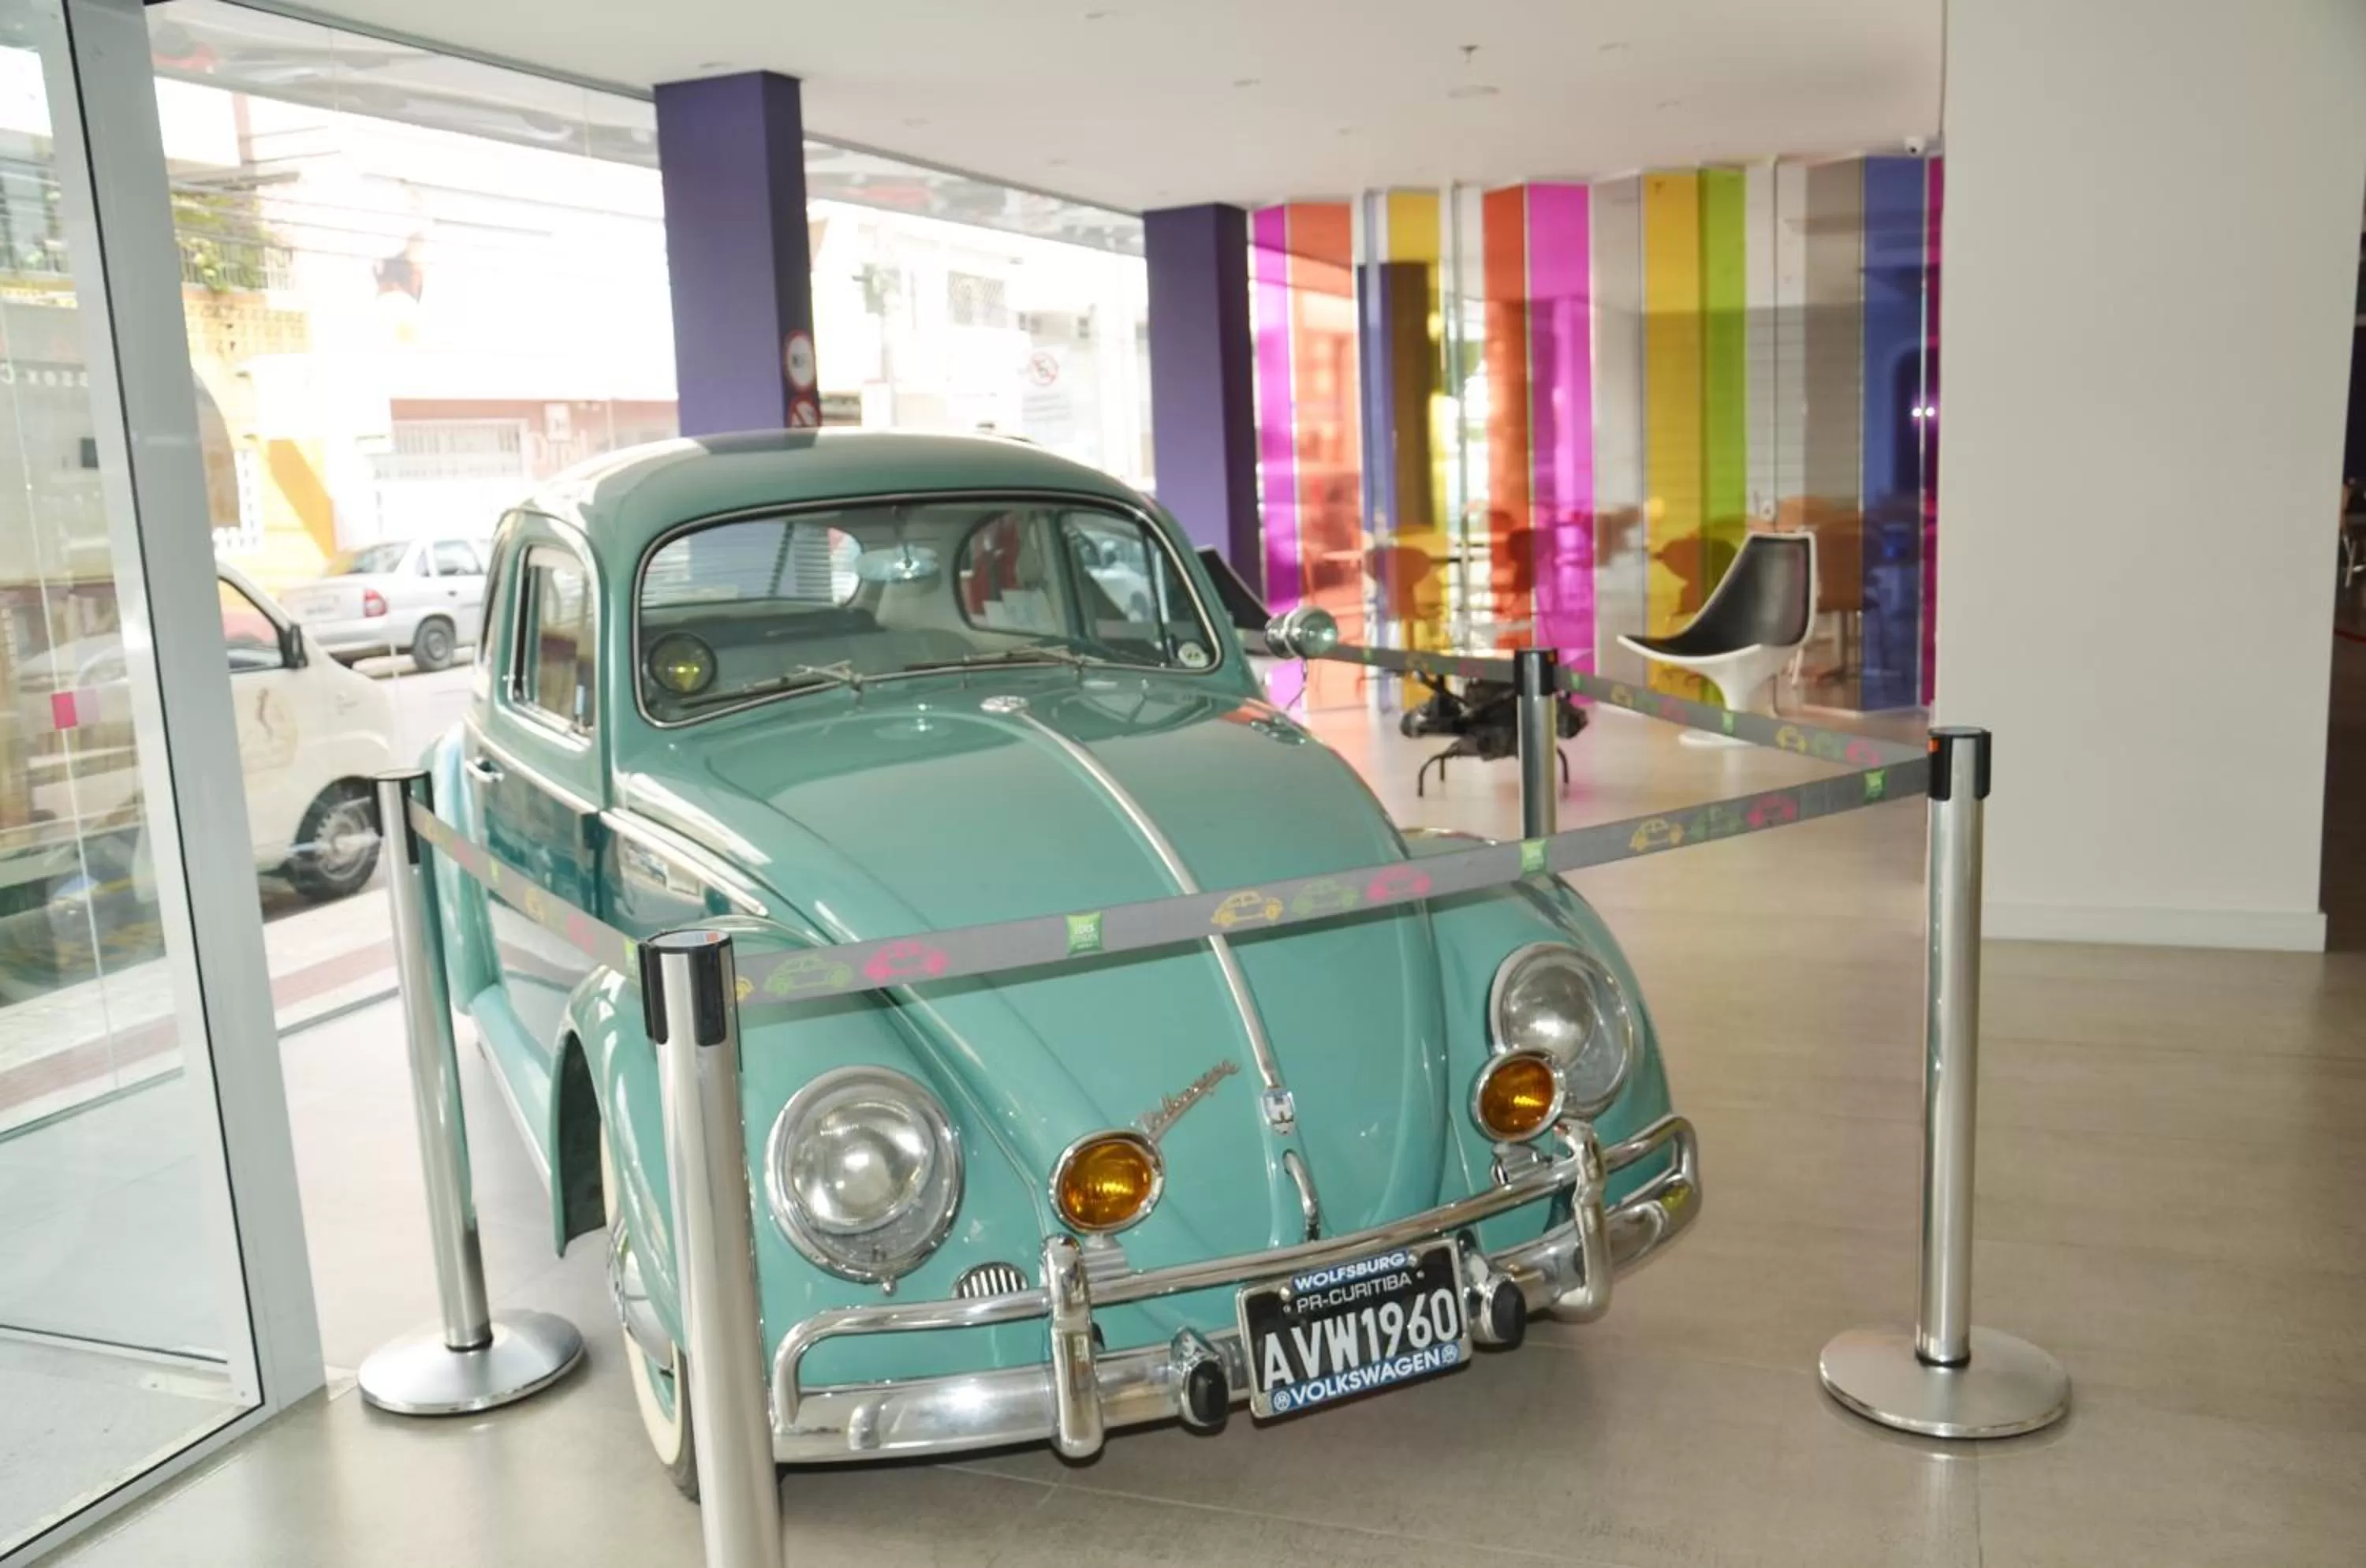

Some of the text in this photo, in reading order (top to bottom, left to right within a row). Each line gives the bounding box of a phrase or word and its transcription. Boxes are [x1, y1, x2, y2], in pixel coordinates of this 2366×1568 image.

[1295, 1252, 1406, 1290] WOLFSBURG
[1297, 1271, 1413, 1313] PR-CURITIBA
[1263, 1288, 1459, 1391] AVW1960
[1290, 1352, 1440, 1405] VOLKSWAGEN
